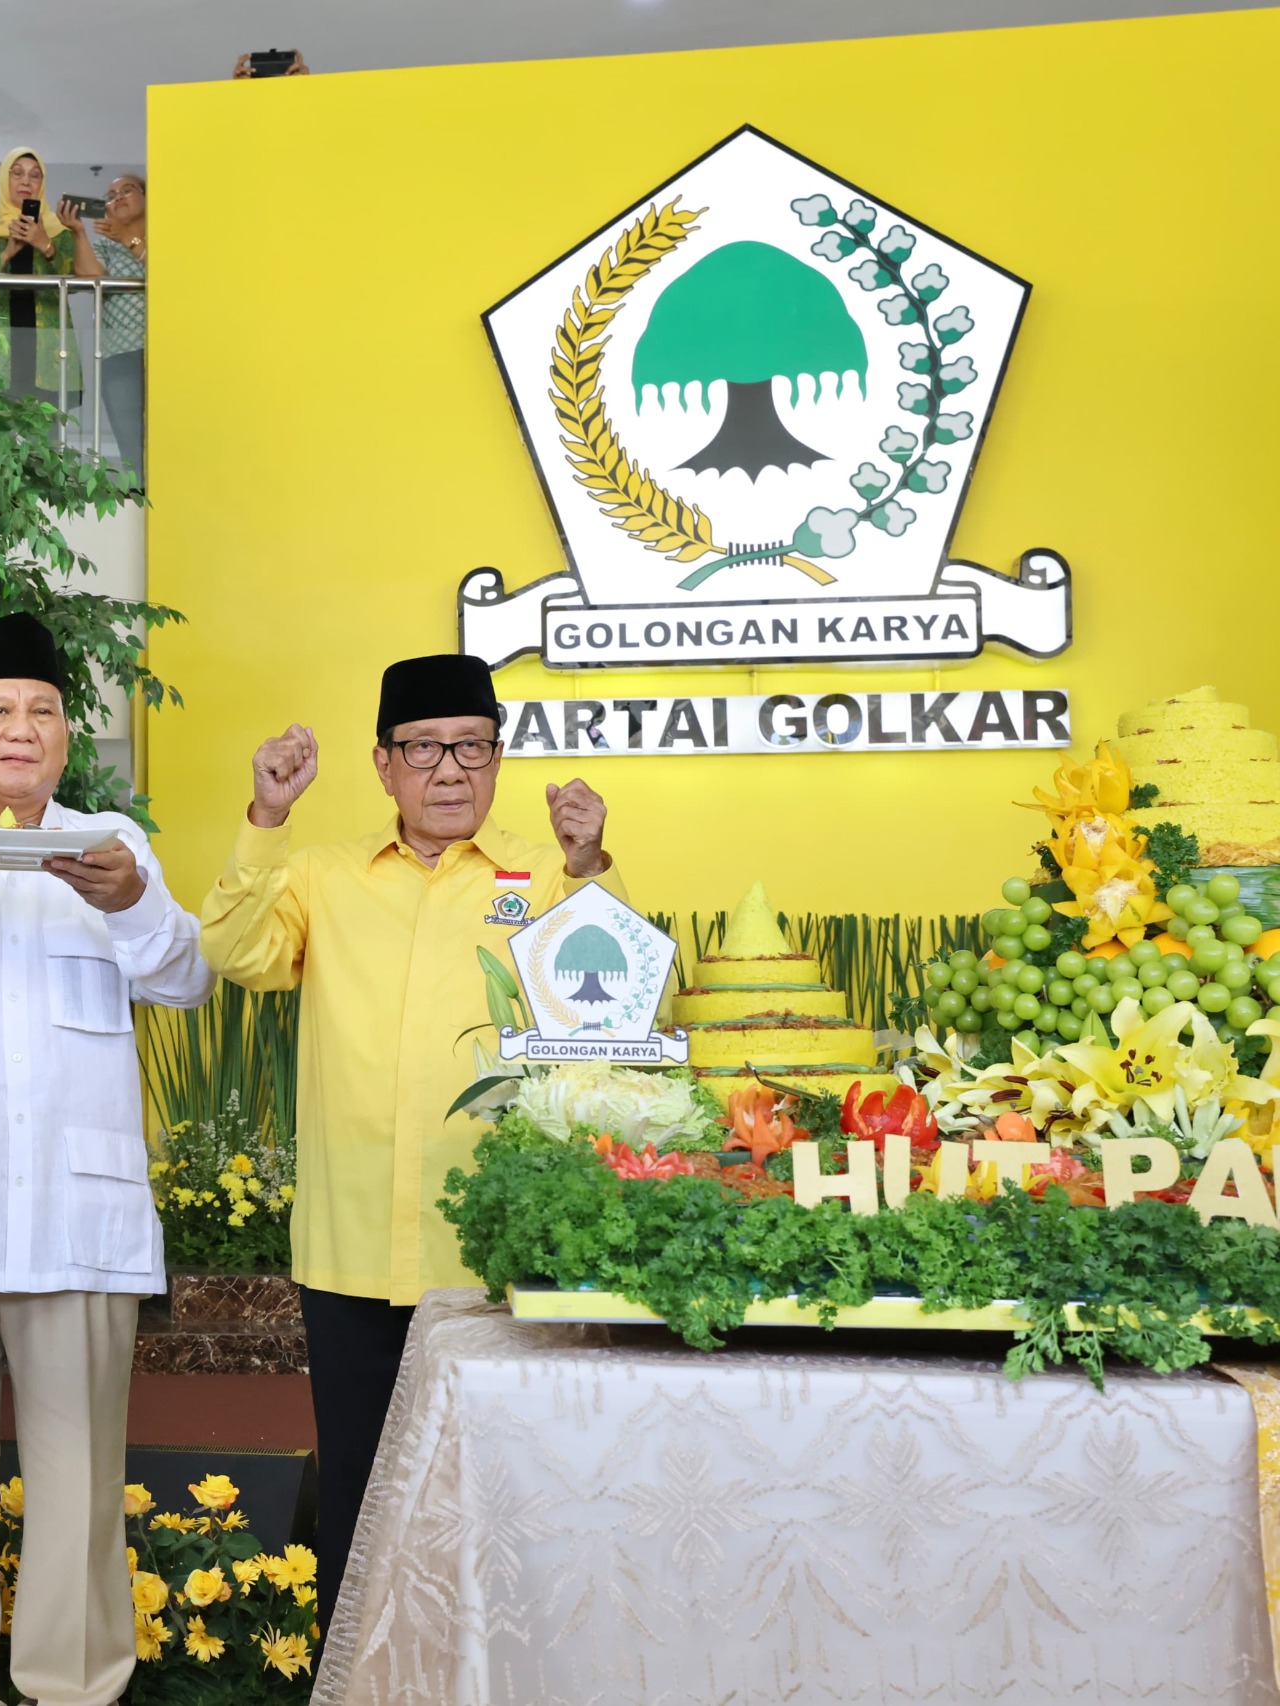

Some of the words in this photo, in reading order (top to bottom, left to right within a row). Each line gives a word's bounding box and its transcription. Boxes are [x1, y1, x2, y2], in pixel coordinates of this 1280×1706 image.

[553, 617, 799, 650] GOLONGAN
[819, 613, 970, 644] KARYA
[496, 697, 729, 751] ARTAI
[757, 689, 1073, 747] GOLKAR
[531, 1044, 608, 1057] GOLONGAN
[612, 1046, 658, 1058] KARYA
[792, 1133, 1052, 1217] HUT
[1100, 1136, 1280, 1230] PA
